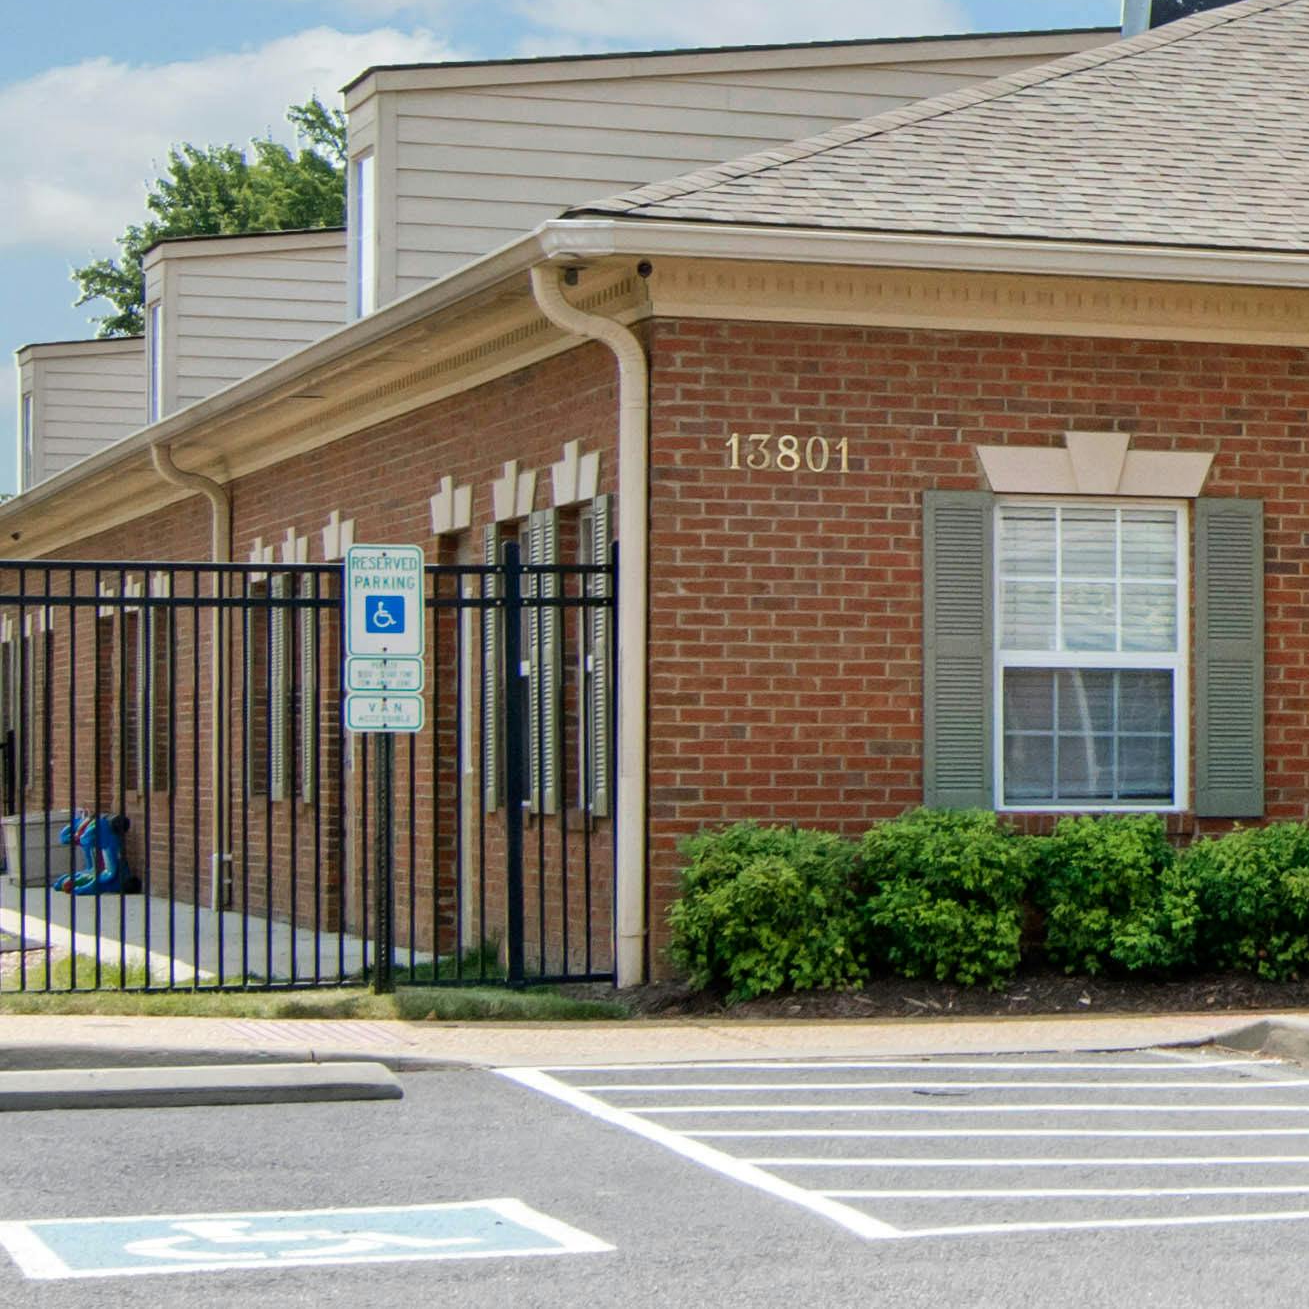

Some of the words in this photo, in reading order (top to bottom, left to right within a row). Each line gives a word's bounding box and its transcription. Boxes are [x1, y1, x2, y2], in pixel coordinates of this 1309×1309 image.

[725, 432, 851, 473] 13801
[352, 556, 418, 571] RESERVED
[354, 575, 416, 590] PARKING
[368, 702, 402, 713] VAN
